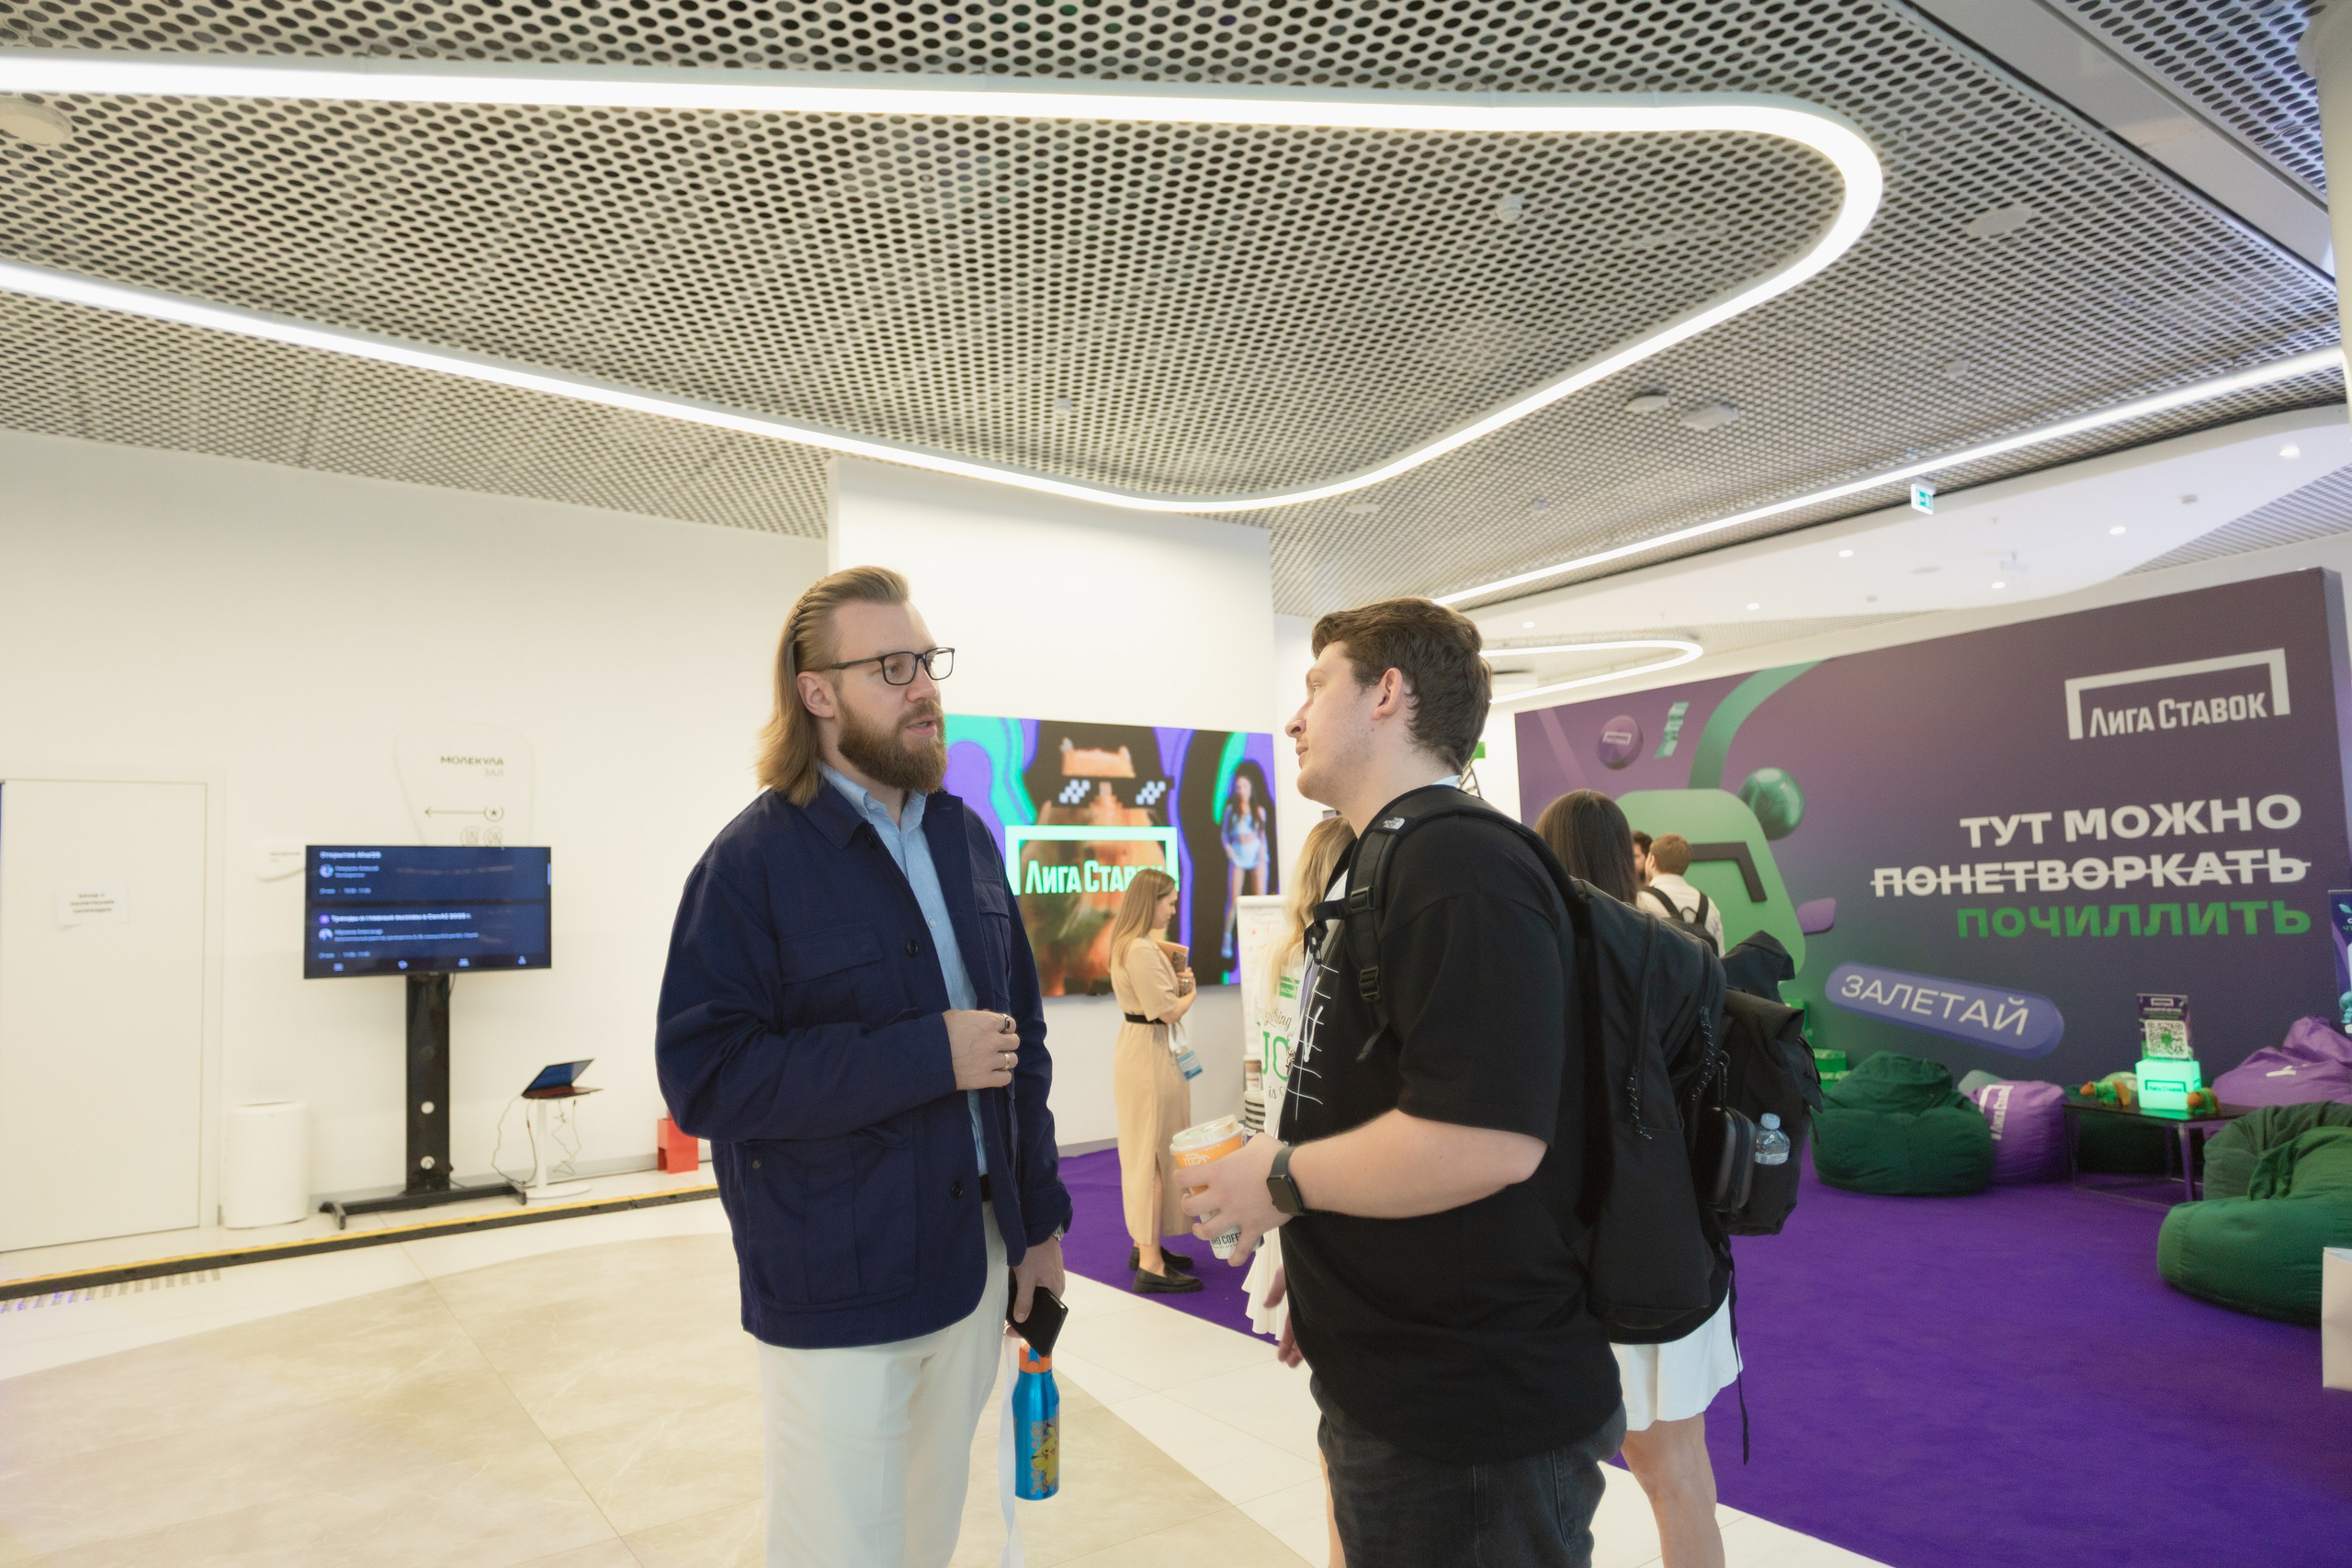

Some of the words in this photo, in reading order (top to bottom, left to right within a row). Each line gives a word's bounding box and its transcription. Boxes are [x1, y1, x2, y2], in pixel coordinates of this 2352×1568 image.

[440, 755, 503, 765] МОЛЕКУЛА
[1960, 812, 2052, 848] ТУТ
[2064, 795, 2301, 842] МОЖНО
[1871, 848, 2310, 897] ПОНЕТВОРКАТЬ
[1956, 900, 2312, 938] ПОЧИЛЛИТЬ
[1841, 975, 2030, 1036] ЗАЛЕТАЙ
